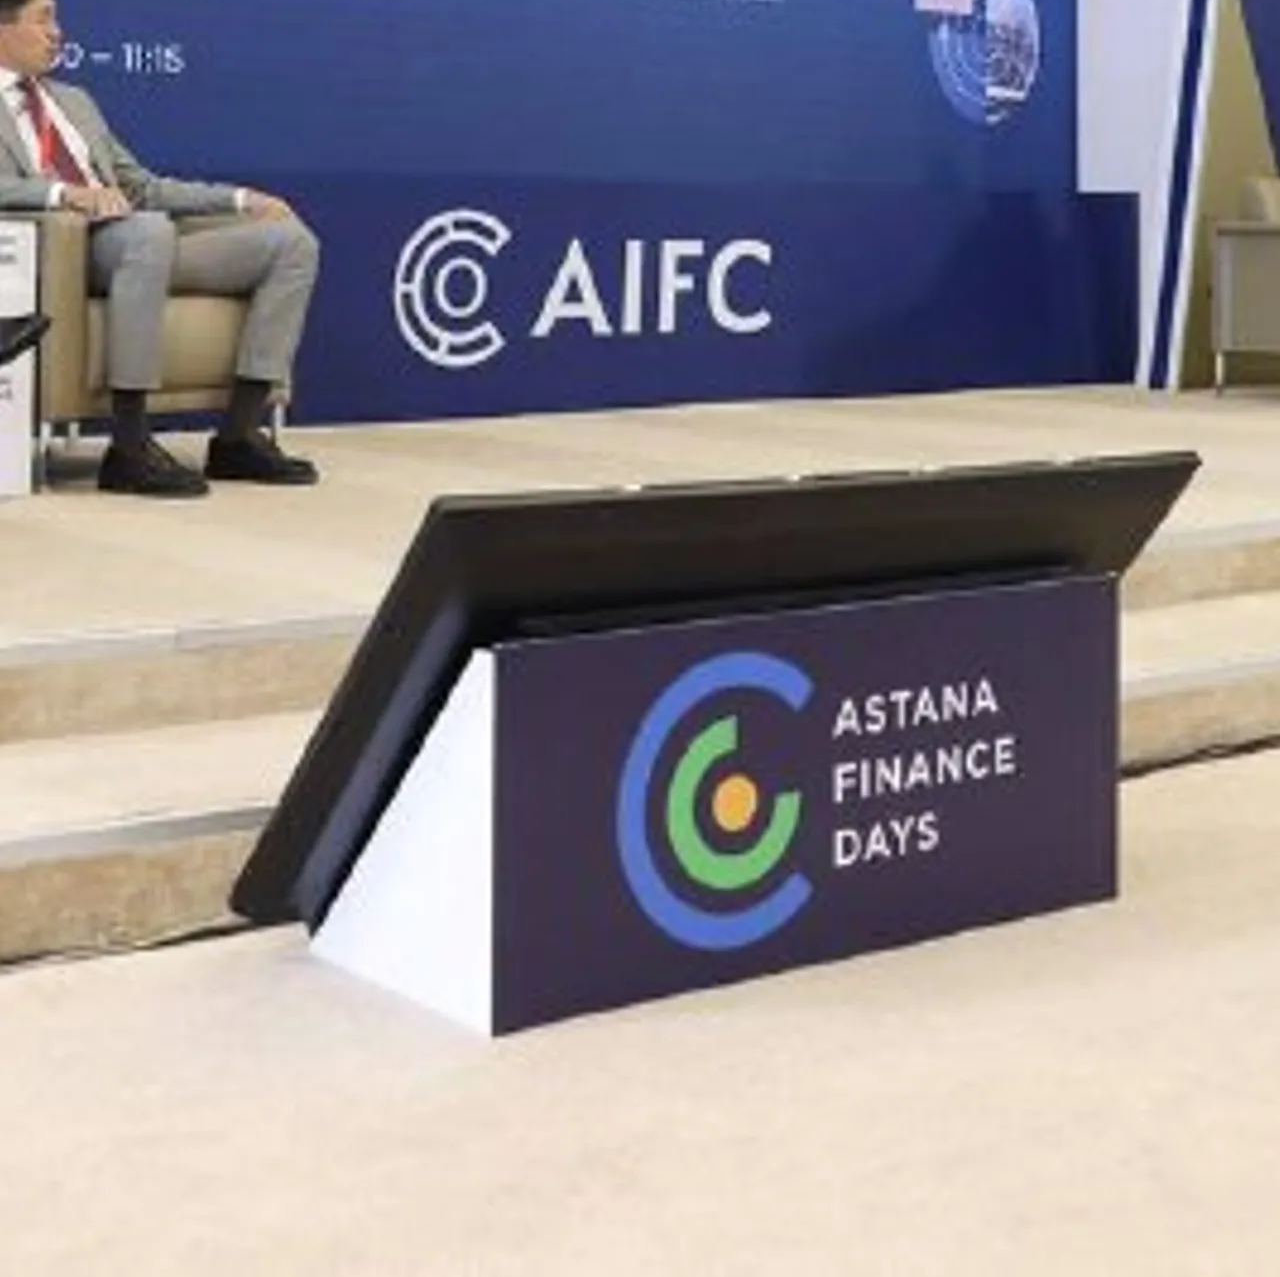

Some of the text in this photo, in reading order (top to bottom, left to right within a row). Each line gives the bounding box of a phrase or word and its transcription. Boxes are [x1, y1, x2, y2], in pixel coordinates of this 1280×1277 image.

[121, 42, 186, 74] 11:15
[530, 236, 773, 338] AIFC
[832, 678, 1001, 739] ASTANA
[832, 736, 1018, 804] FINANCE
[832, 812, 941, 870] DAYS
